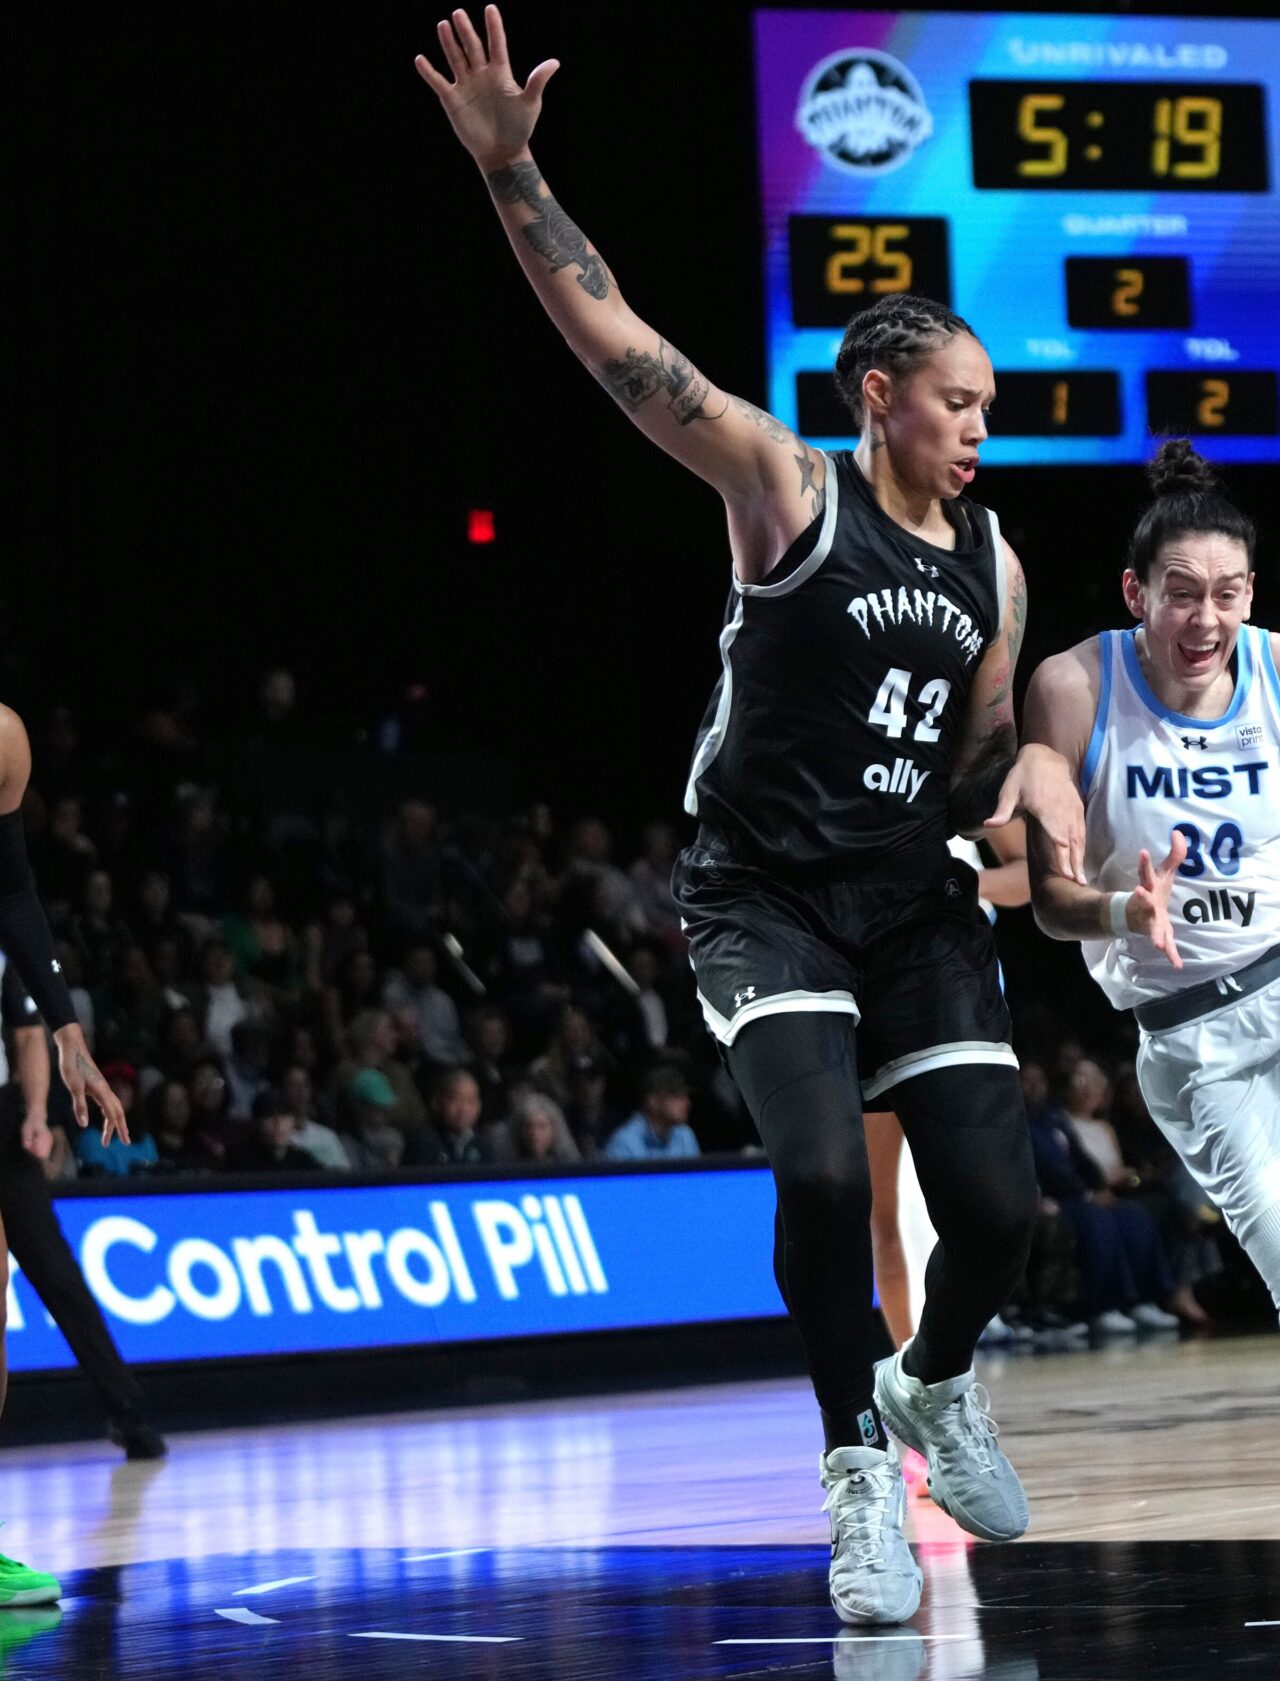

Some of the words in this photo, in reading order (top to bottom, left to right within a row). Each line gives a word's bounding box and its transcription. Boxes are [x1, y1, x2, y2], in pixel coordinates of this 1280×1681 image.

[1008, 37, 1228, 69] UNRIVALED
[1062, 214, 1188, 236] QUARTER
[827, 225, 912, 294] 25
[1112, 270, 1143, 316] 2
[1027, 338, 1074, 359] TOL
[1185, 338, 1239, 360] TOL
[1053, 383, 1068, 424] 1
[1199, 379, 1230, 426] 2
[846, 585, 984, 666] PHANTOM
[867, 667, 952, 743] 42
[863, 757, 931, 803] ally
[1126, 761, 1269, 799] MIST
[1171, 822, 1243, 877] 30
[1182, 888, 1256, 928] ally
[81, 1202, 476, 1324] Control
[472, 1194, 608, 1300] Pill
